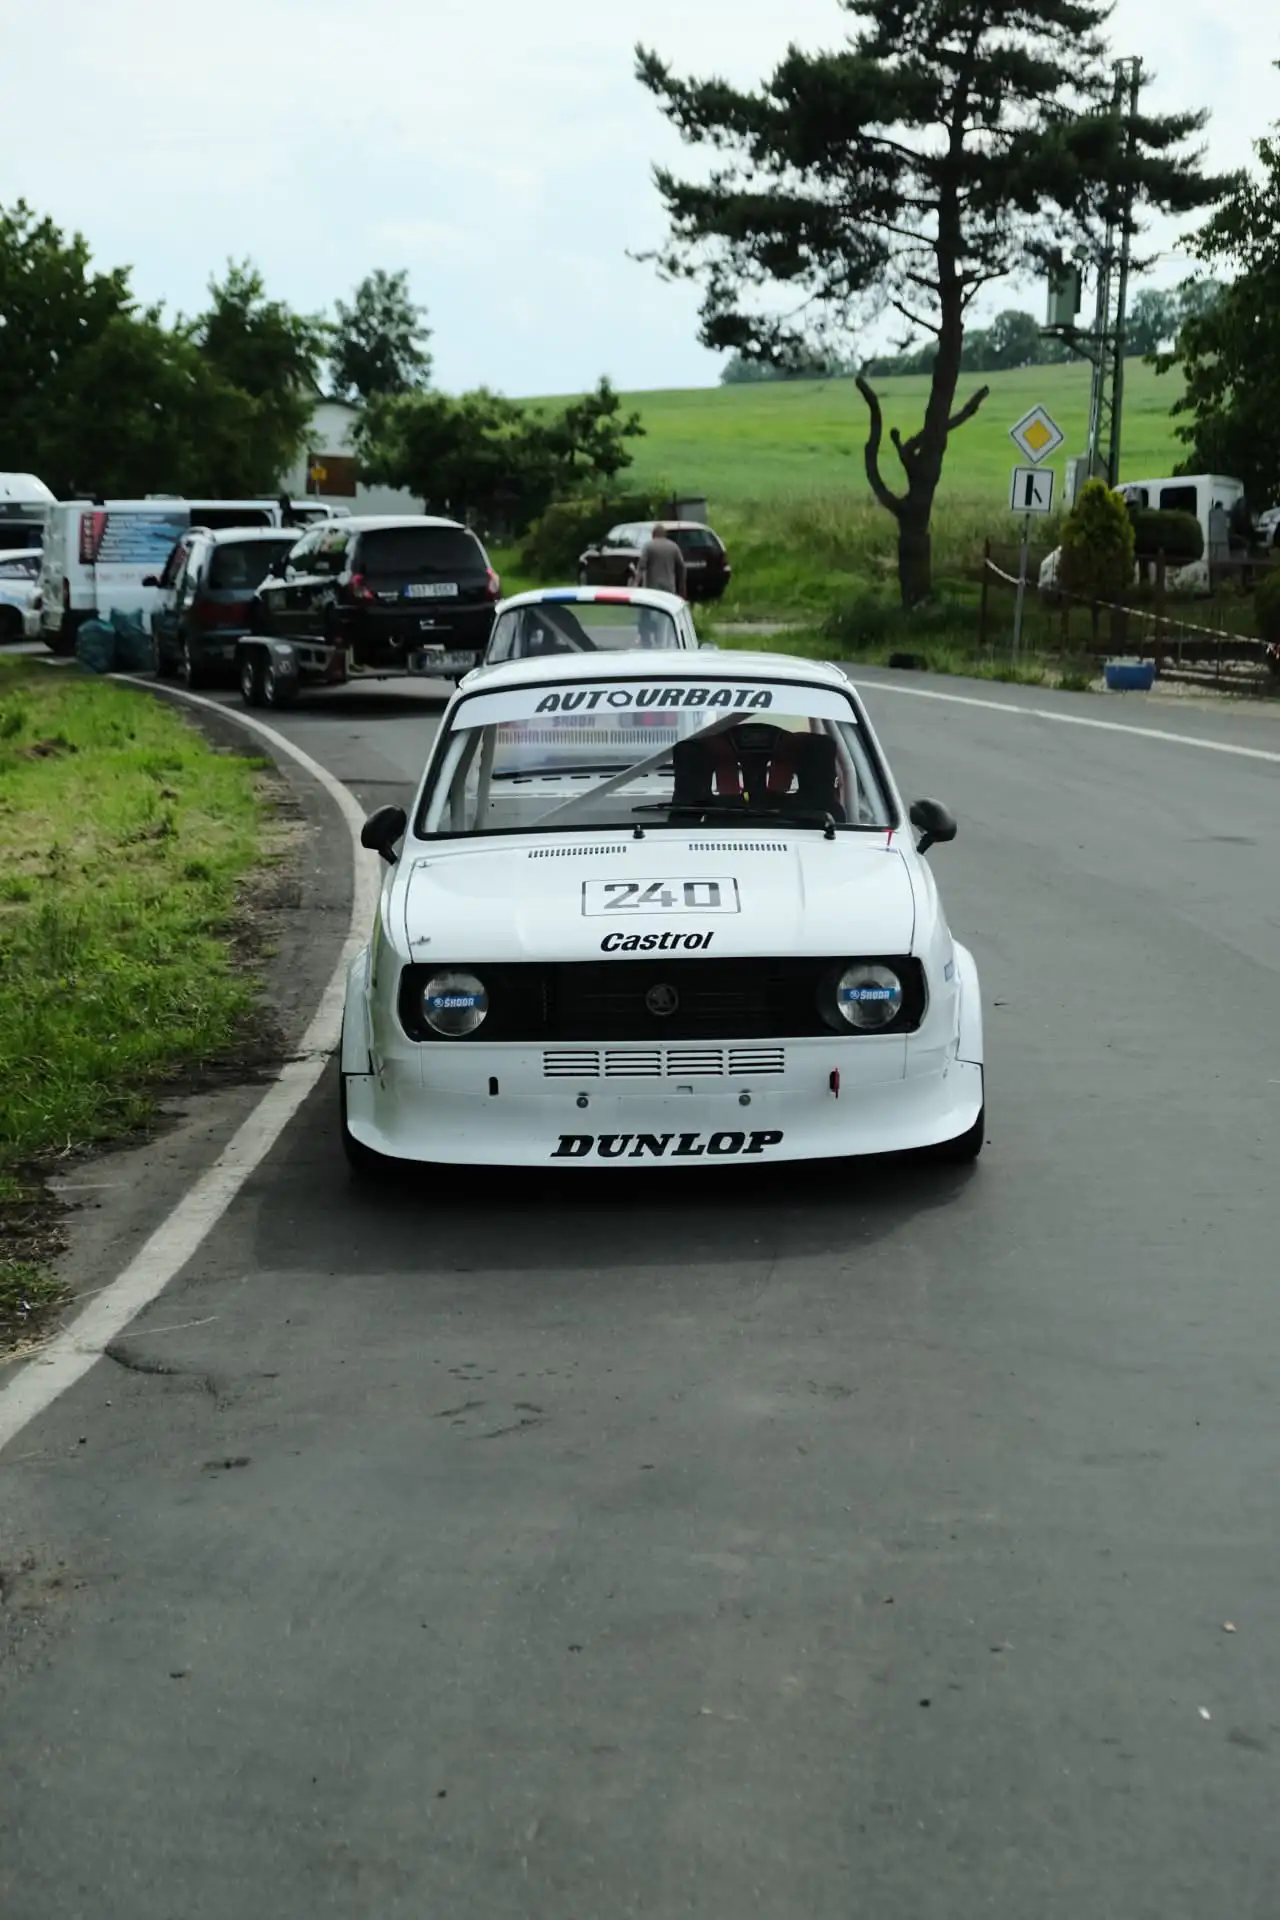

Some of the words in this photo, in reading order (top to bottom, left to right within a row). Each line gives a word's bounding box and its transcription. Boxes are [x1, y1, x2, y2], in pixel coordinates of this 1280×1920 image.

[534, 688, 773, 713] AUTOURBATA
[604, 882, 721, 909] 240
[600, 931, 715, 952] Castrol
[550, 1130, 784, 1158] DUNLOP
